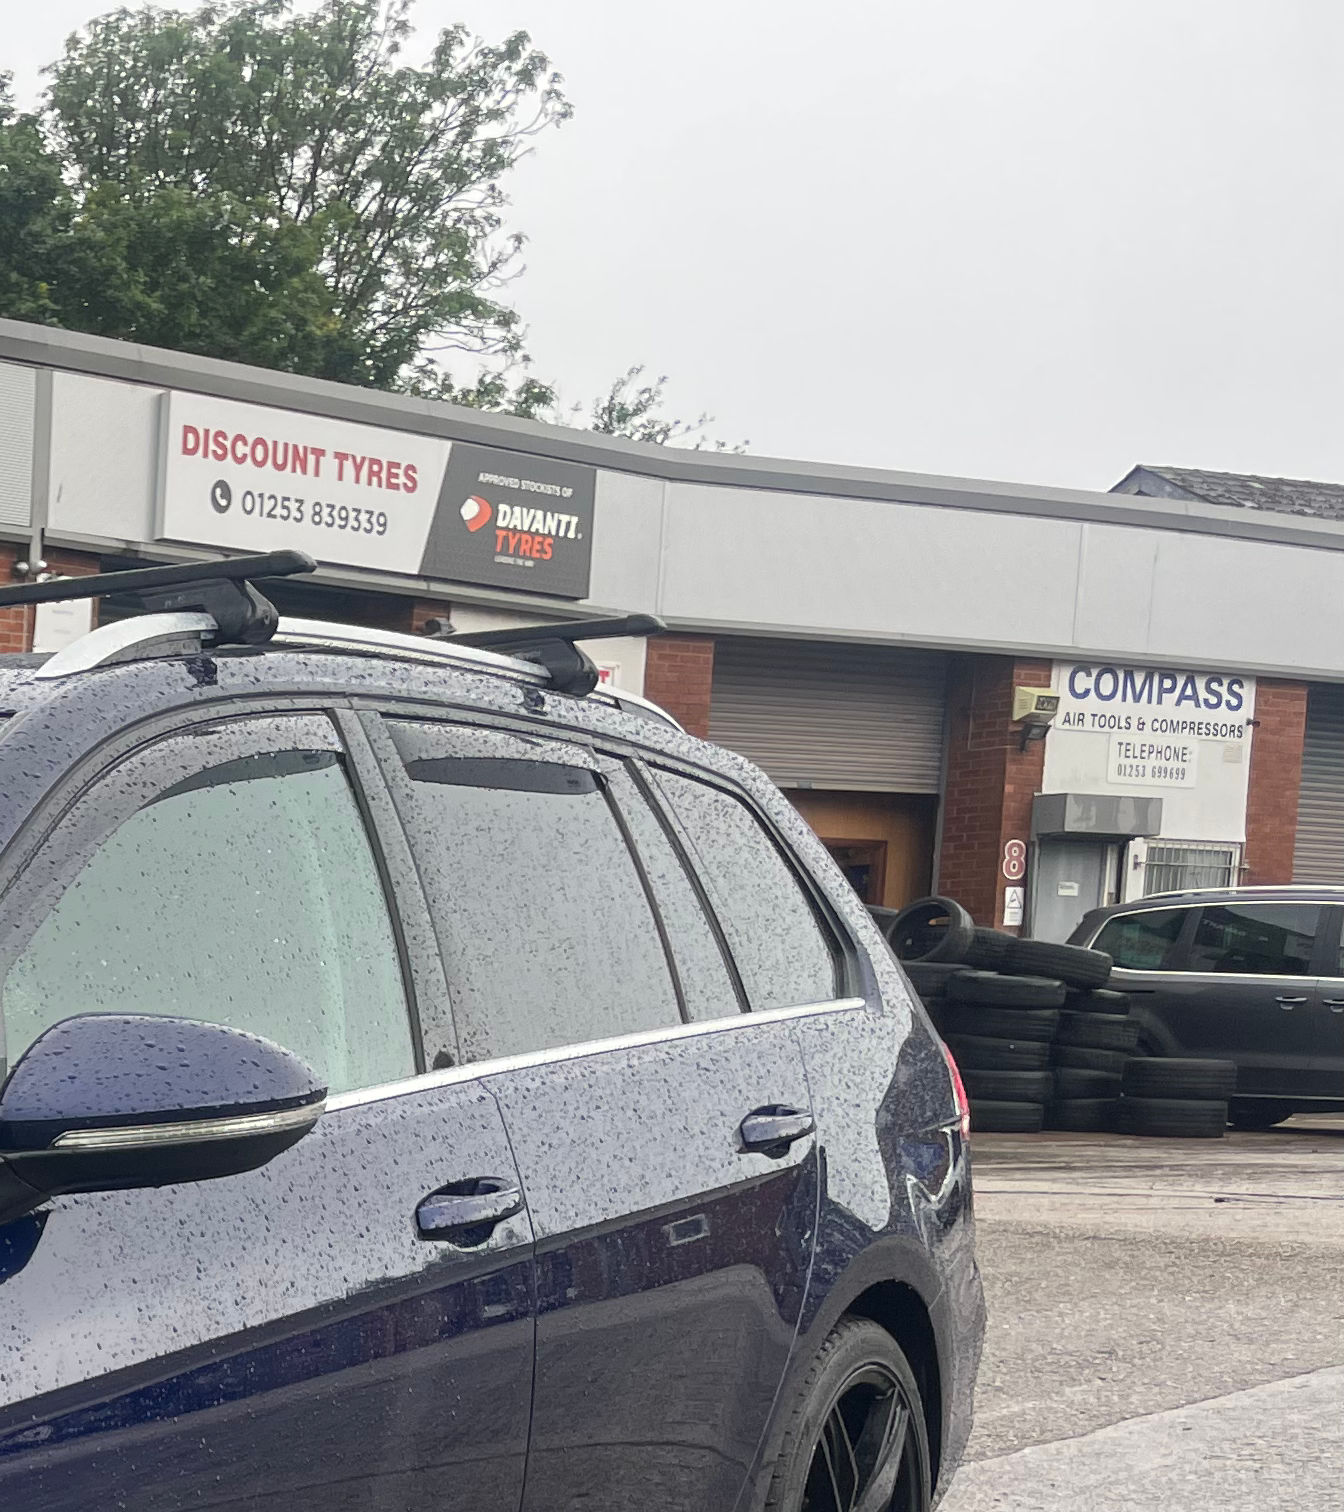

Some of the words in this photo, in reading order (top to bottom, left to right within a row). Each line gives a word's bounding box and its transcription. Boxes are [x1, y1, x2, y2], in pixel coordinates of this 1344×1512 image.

[181, 424, 326, 477] DISCOUNT
[333, 451, 419, 493] TYRES
[242, 490, 304, 523] 01253
[311, 501, 388, 536] 839339
[495, 529, 554, 560] TYRES
[1068, 665, 1245, 712] COMPASS
[1062, 711, 1085, 728] AIR
[1090, 714, 1131, 731] TOOLS
[1151, 718, 1244, 739] COMPRESSORS
[1117, 765, 1146, 778] 01253
[1151, 767, 1186, 780] 699699
[1002, 839, 1027, 880] 8
